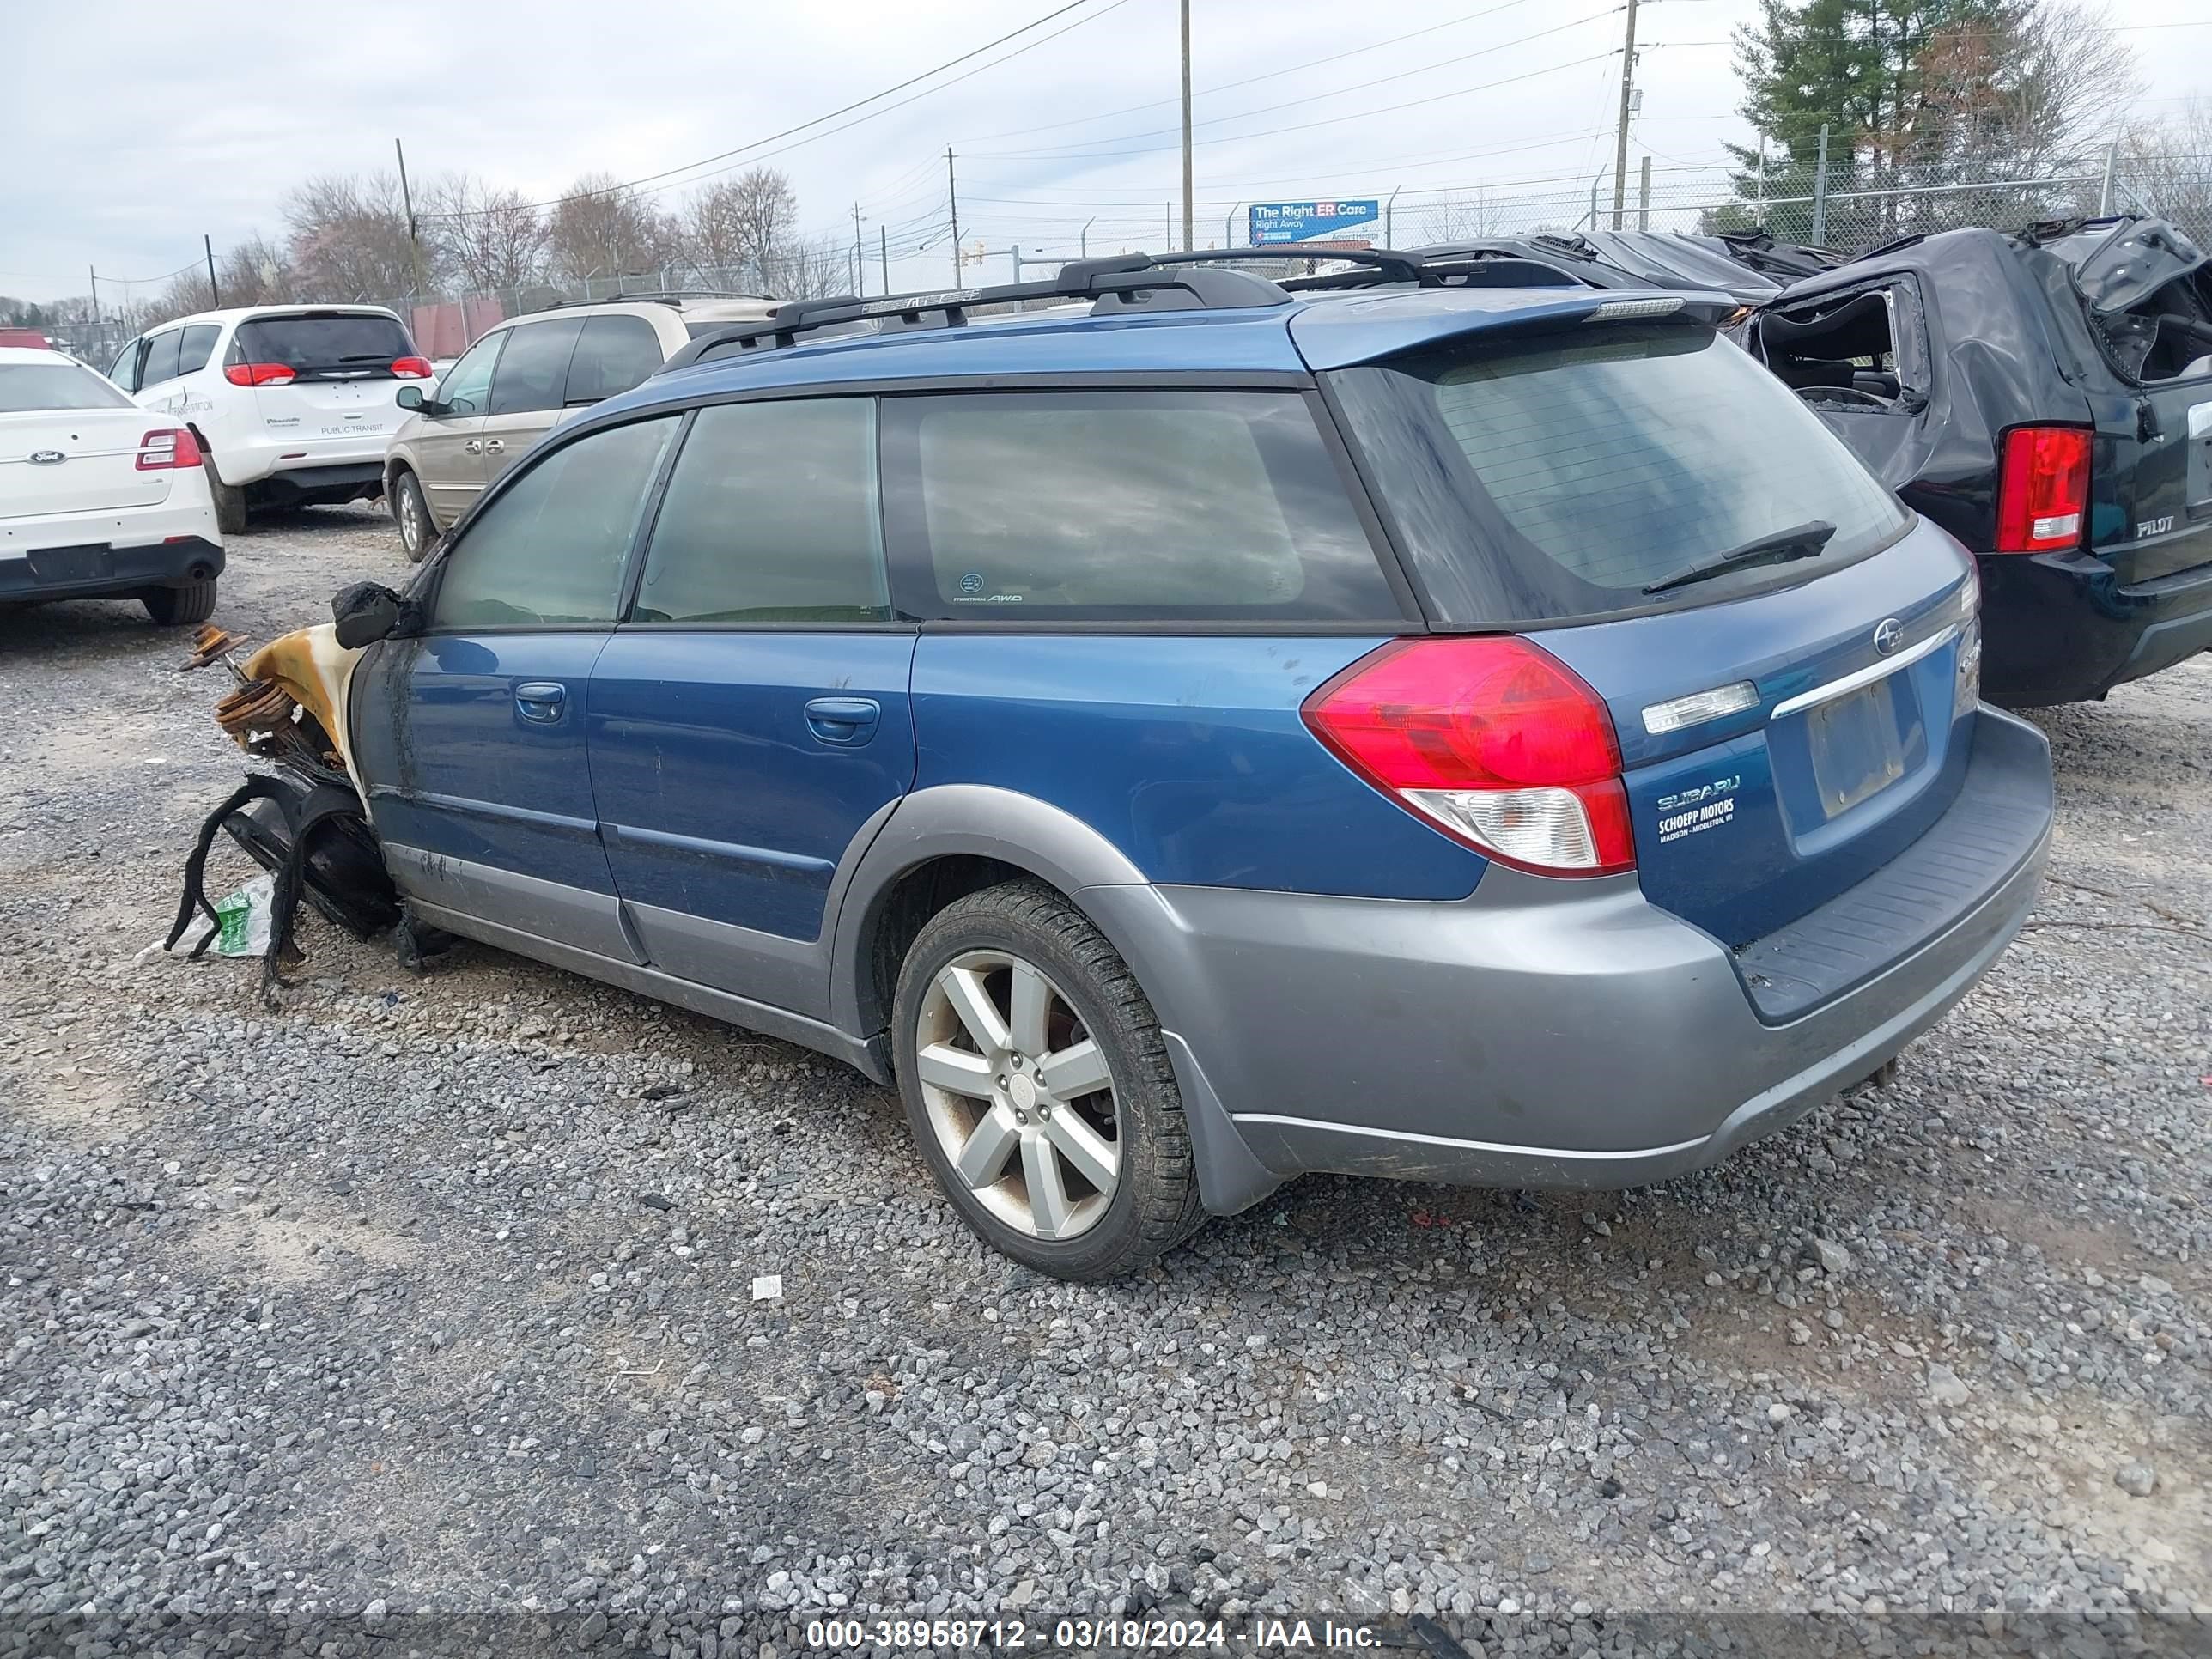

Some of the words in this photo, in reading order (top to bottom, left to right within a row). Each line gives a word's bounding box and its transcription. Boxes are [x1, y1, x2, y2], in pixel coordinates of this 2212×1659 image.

[1255, 206, 1279, 218] The
[1282, 205, 1314, 221] Right
[1317, 204, 1334, 216] ER
[1337, 204, 1367, 216] Care
[1256, 220, 1278, 230] Right
[1279, 220, 1304, 229] Away
[321, 426, 350, 434] PUBLIC
[352, 423, 384, 433] TRANSIT
[35, 451, 59, 461] Ford
[2137, 515, 2174, 538] PILOT
[1656, 775, 1741, 811] SUBARU
[1659, 810, 1698, 835] SCHOEPP
[1700, 798, 1735, 821] MOTORS
[1660, 829, 1689, 843] MADISON
[1692, 817, 1725, 833] MIDDLETON,
[1725, 813, 1734, 822] WI
